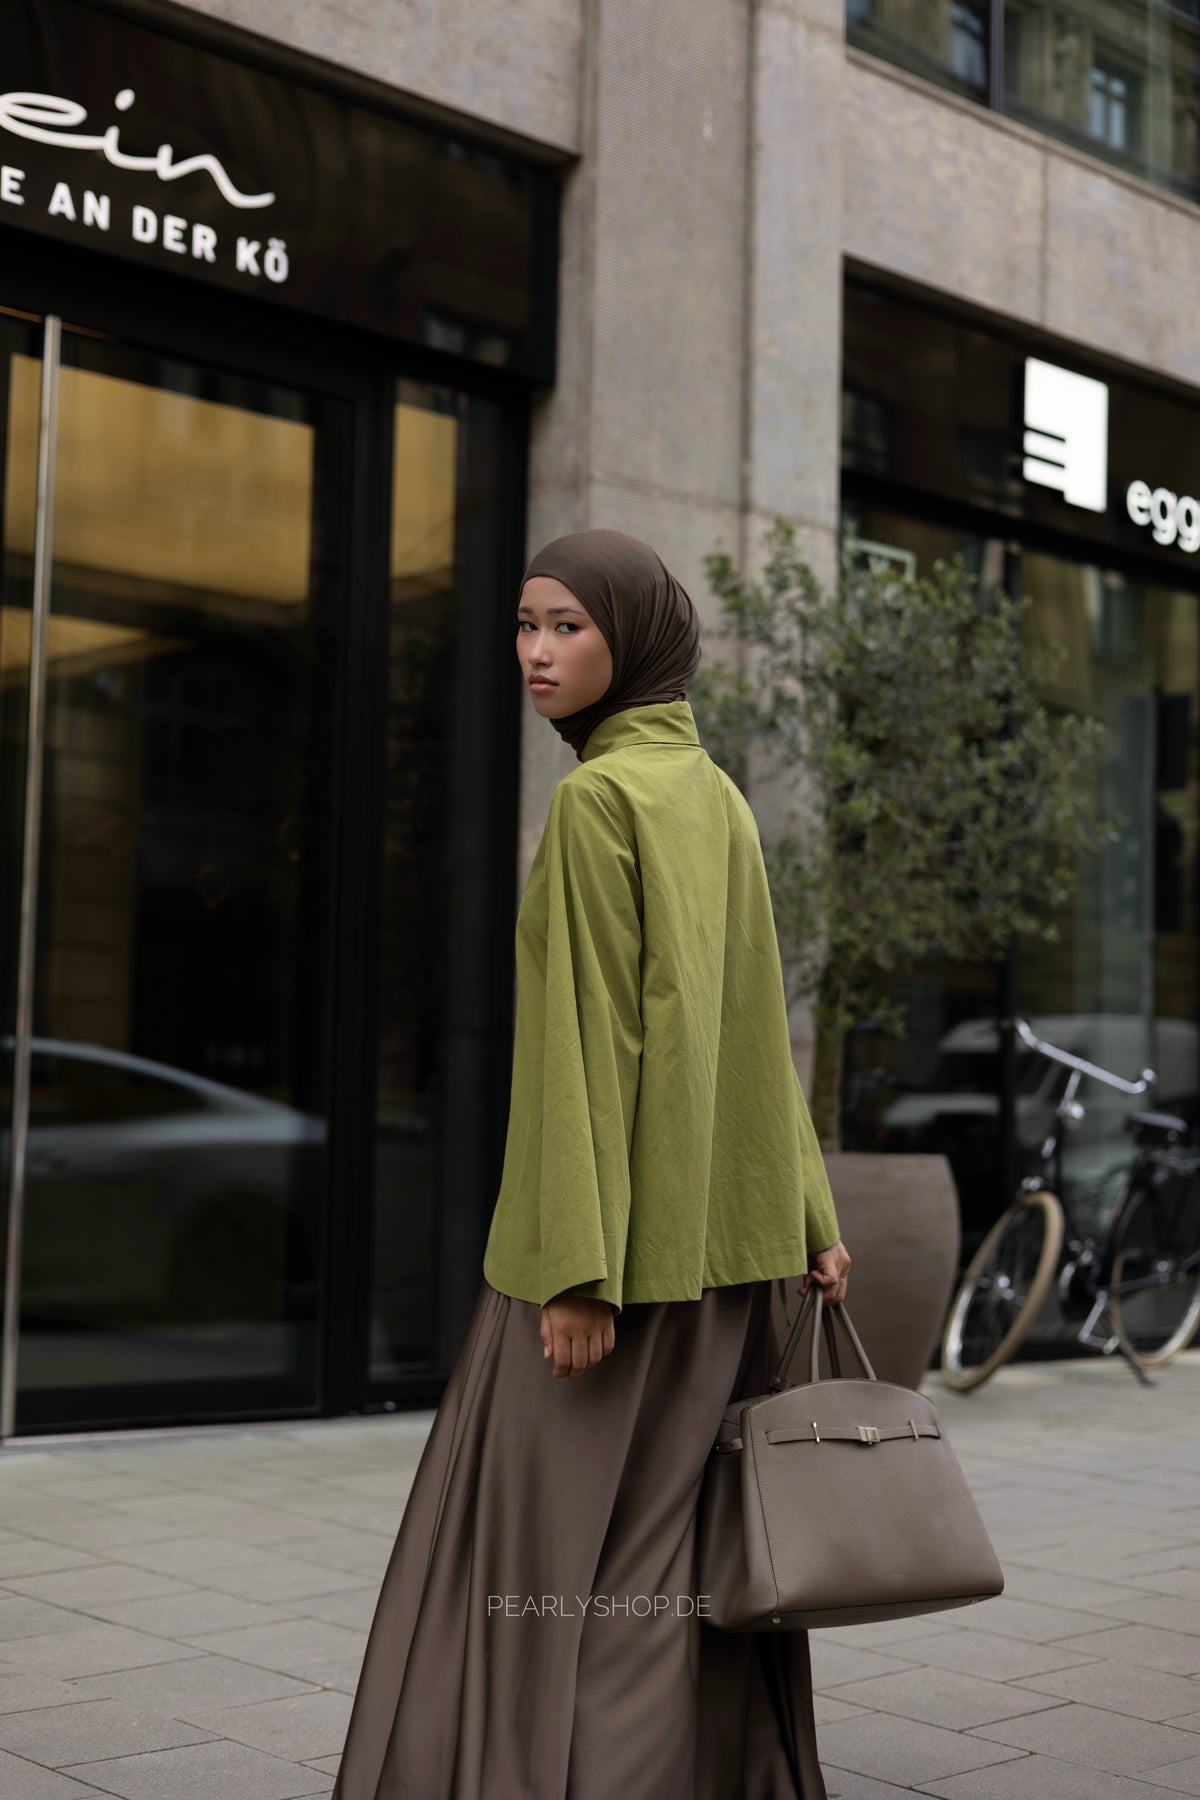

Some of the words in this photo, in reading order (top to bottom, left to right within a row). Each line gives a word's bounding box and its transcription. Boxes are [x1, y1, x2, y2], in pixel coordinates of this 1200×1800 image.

[1, 164, 25, 206] E
[48, 181, 110, 231] AN
[132, 204, 217, 263] DER
[236, 236, 289, 283] KÖ
[1126, 480, 1200, 553] egg
